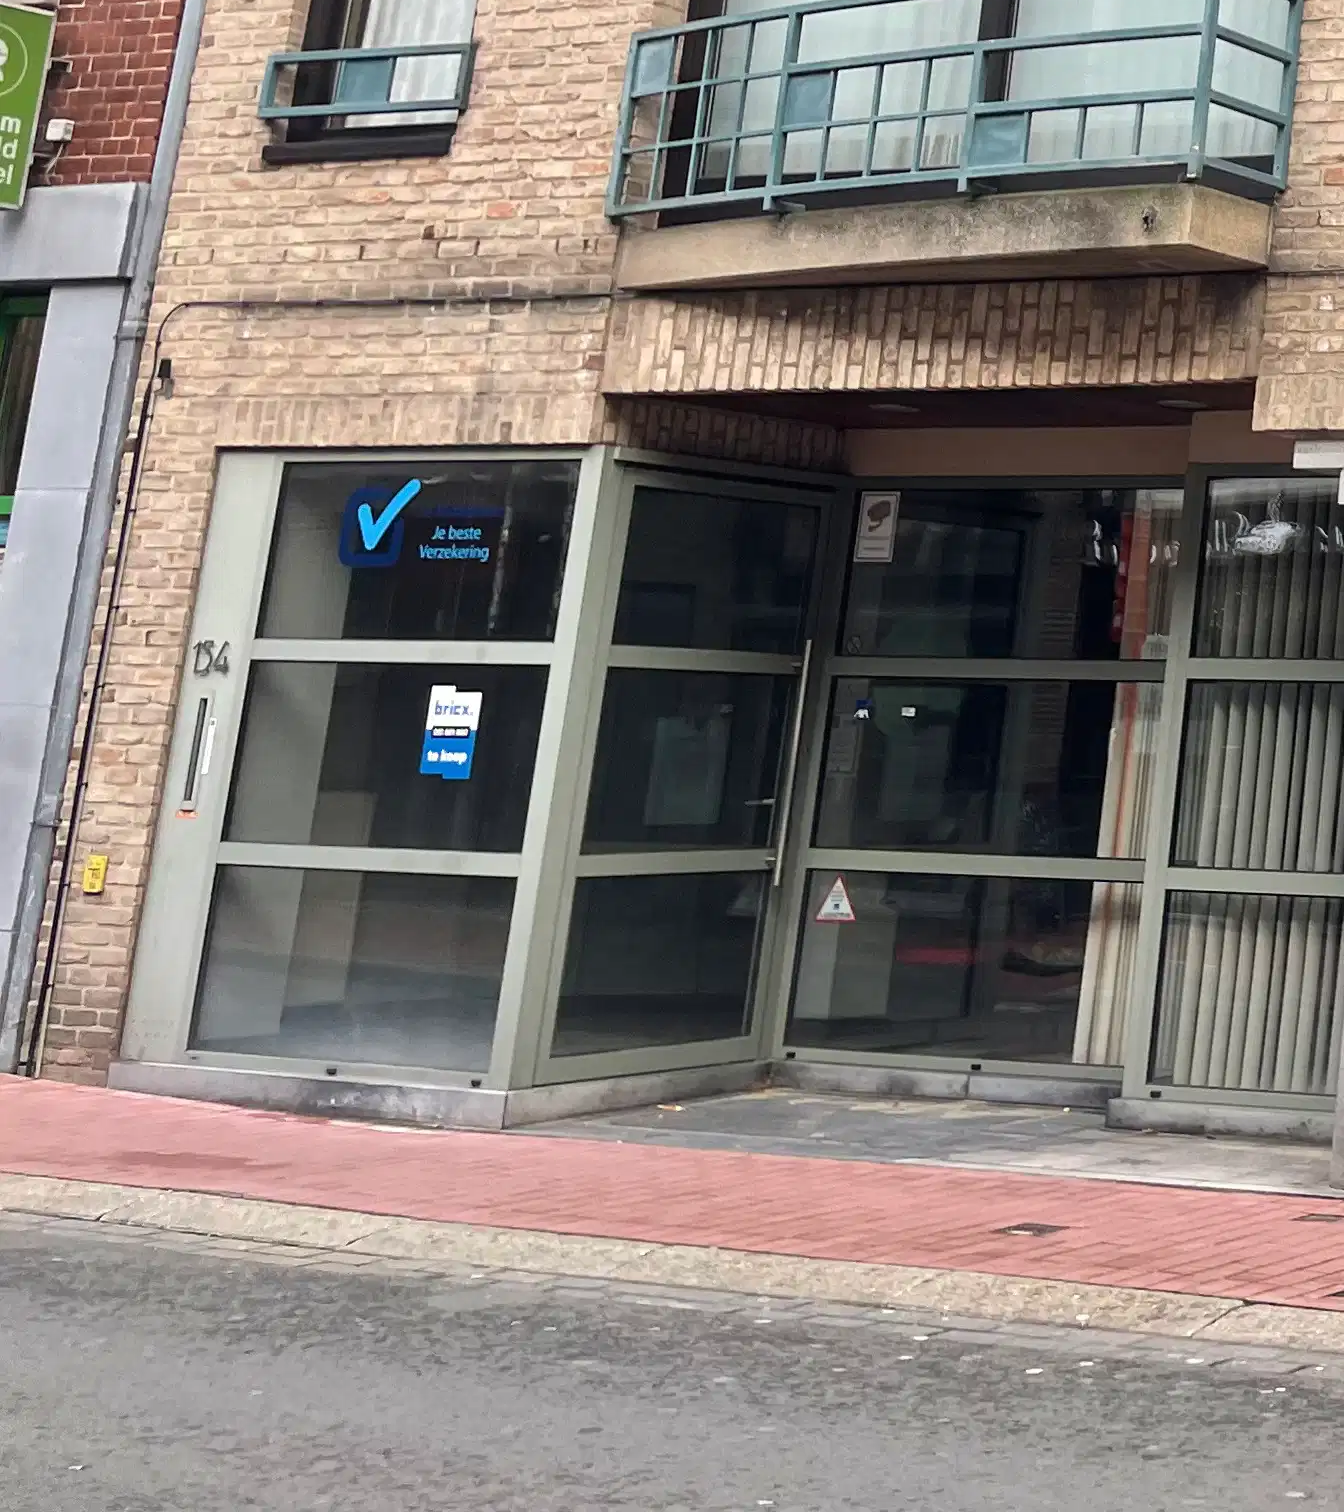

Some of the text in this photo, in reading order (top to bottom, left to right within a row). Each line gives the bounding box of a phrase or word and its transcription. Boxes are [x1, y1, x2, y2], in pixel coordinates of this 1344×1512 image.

[431, 525, 482, 540] Je beste
[419, 544, 490, 562] Verzekering
[193, 640, 230, 676] 154
